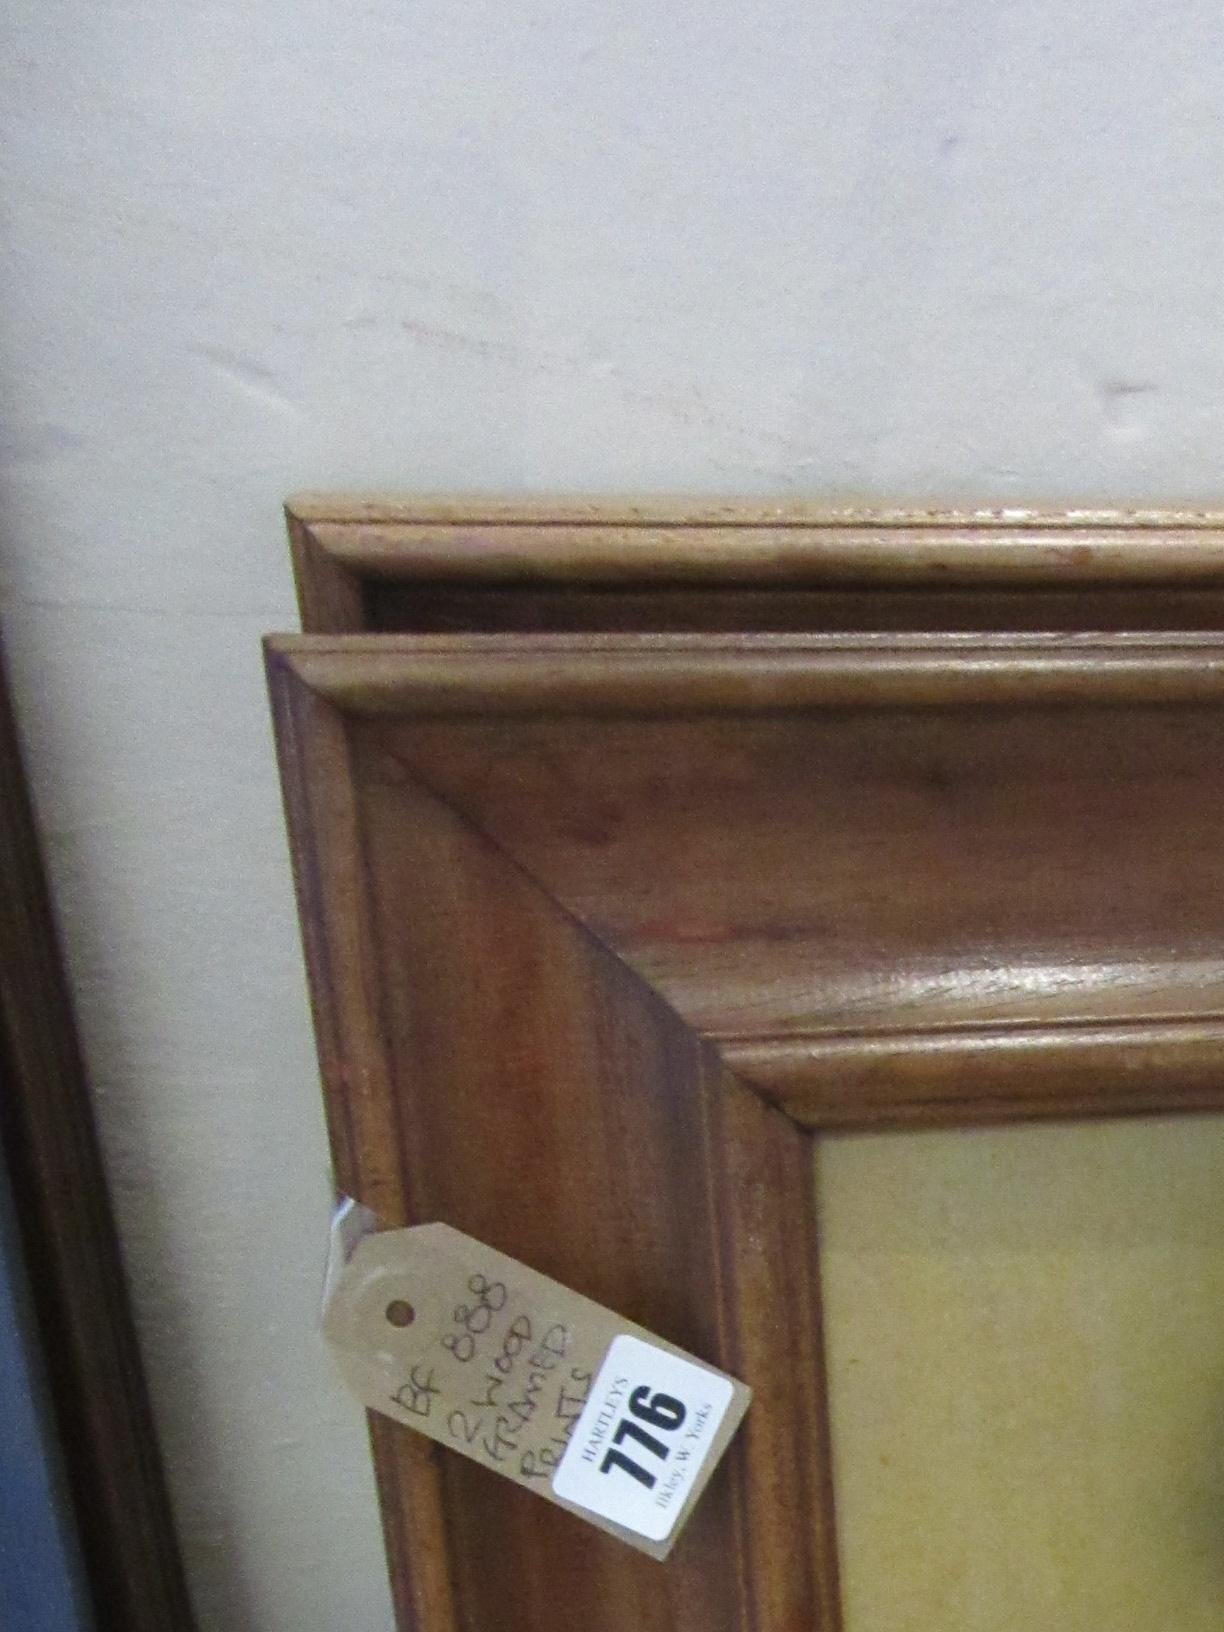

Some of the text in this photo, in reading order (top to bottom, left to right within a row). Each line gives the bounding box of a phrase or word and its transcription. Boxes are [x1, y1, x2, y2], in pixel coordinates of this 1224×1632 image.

[391, 1273, 507, 1417] BF 888
[447, 1315, 531, 1443] 2 WOOD
[483, 1324, 567, 1461] FRAMED
[581, 1375, 629, 1463] HARTLEYS
[599, 1385, 687, 1490] 776
[687, 1402, 713, 1440] Yorks
